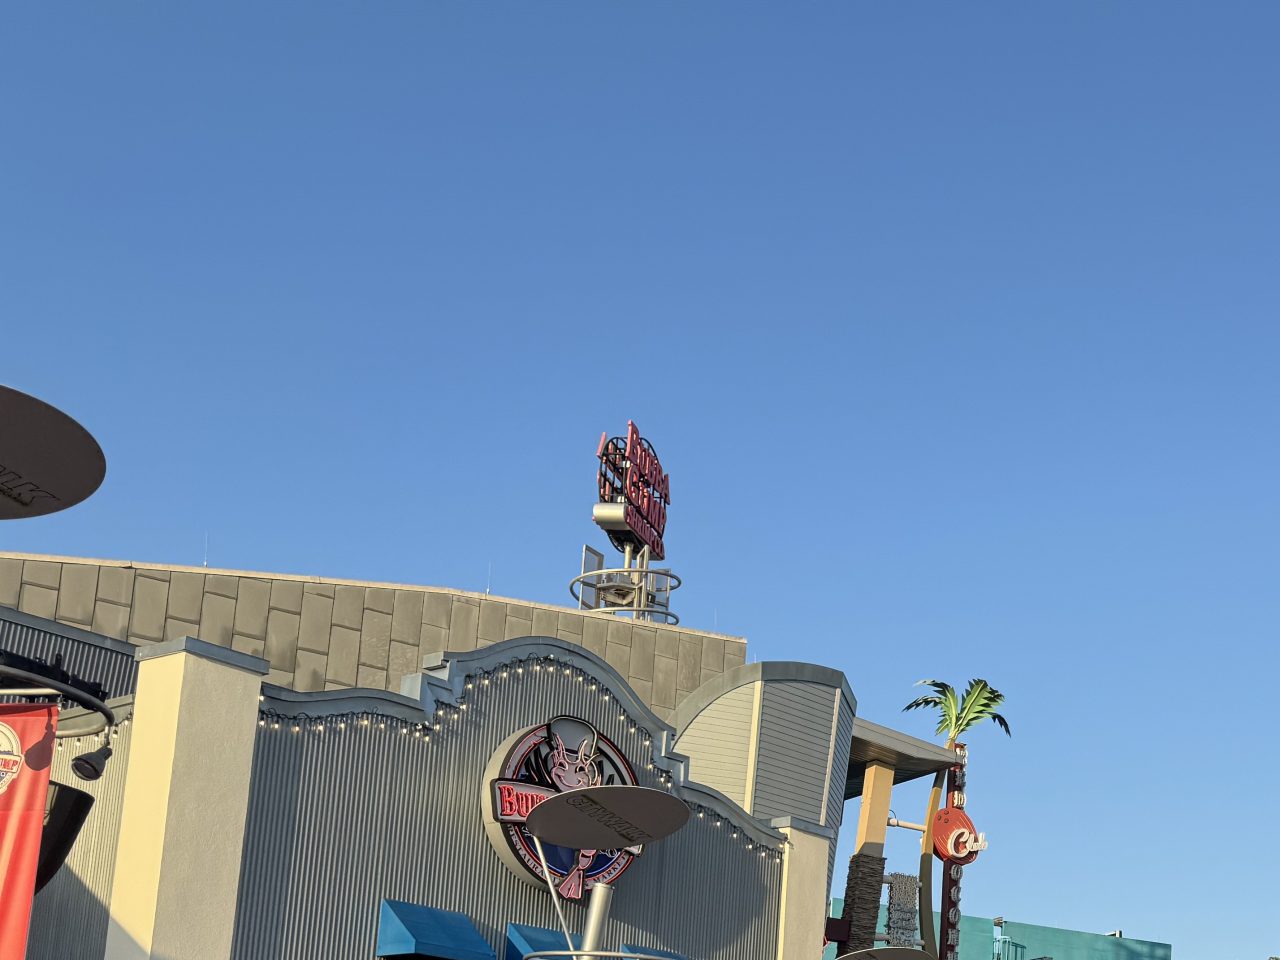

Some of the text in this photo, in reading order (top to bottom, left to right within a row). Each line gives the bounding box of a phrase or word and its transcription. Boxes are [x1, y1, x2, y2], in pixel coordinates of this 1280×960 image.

[625, 420, 670, 505] BUBBA
[627, 464, 667, 539] GUMP
[948, 829, 988, 858] Club
